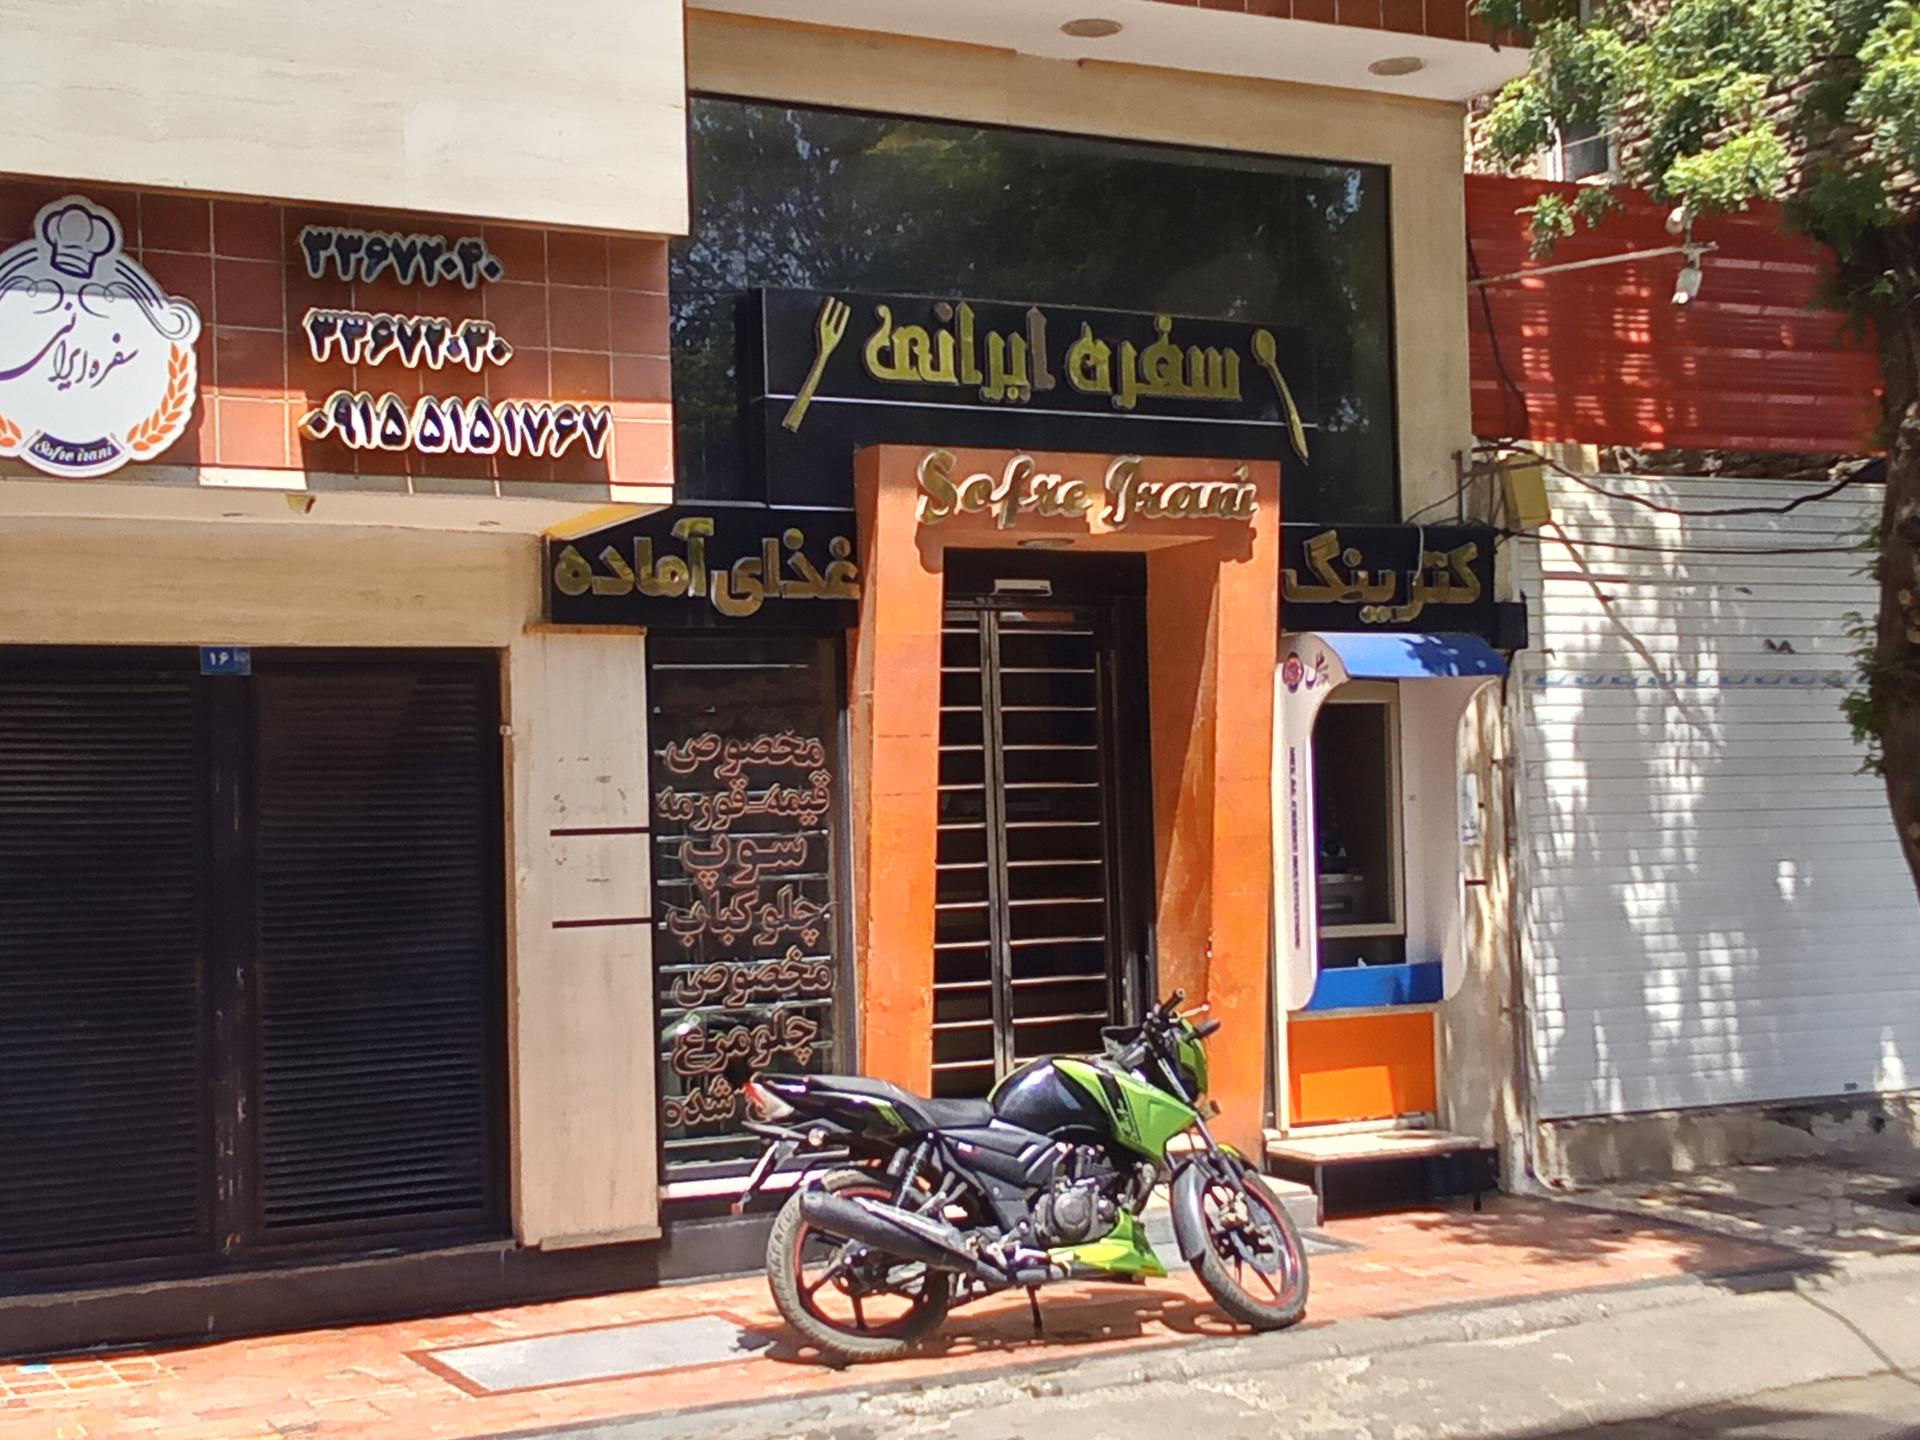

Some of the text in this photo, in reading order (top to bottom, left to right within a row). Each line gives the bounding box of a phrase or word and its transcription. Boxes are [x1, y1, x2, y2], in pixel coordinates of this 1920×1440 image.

[301, 225, 503, 289] ۳۳۶۷۲۰۴۰
[89, 332, 138, 389] سفره
[302, 307, 513, 372] ۳۳۶۷۲۰۳۰
[863, 301, 1243, 410] سفره ایرانی
[915, 450, 1258, 530] Sofre Irani
[554, 517, 861, 617] غذای آماده
[1281, 529, 1481, 624] کترینگ
[666, 726, 825, 779] مخصوص
[680, 834, 808, 890] سوپ
[672, 945, 832, 1008] مخصوص
[662, 1074, 736, 1128] شده
